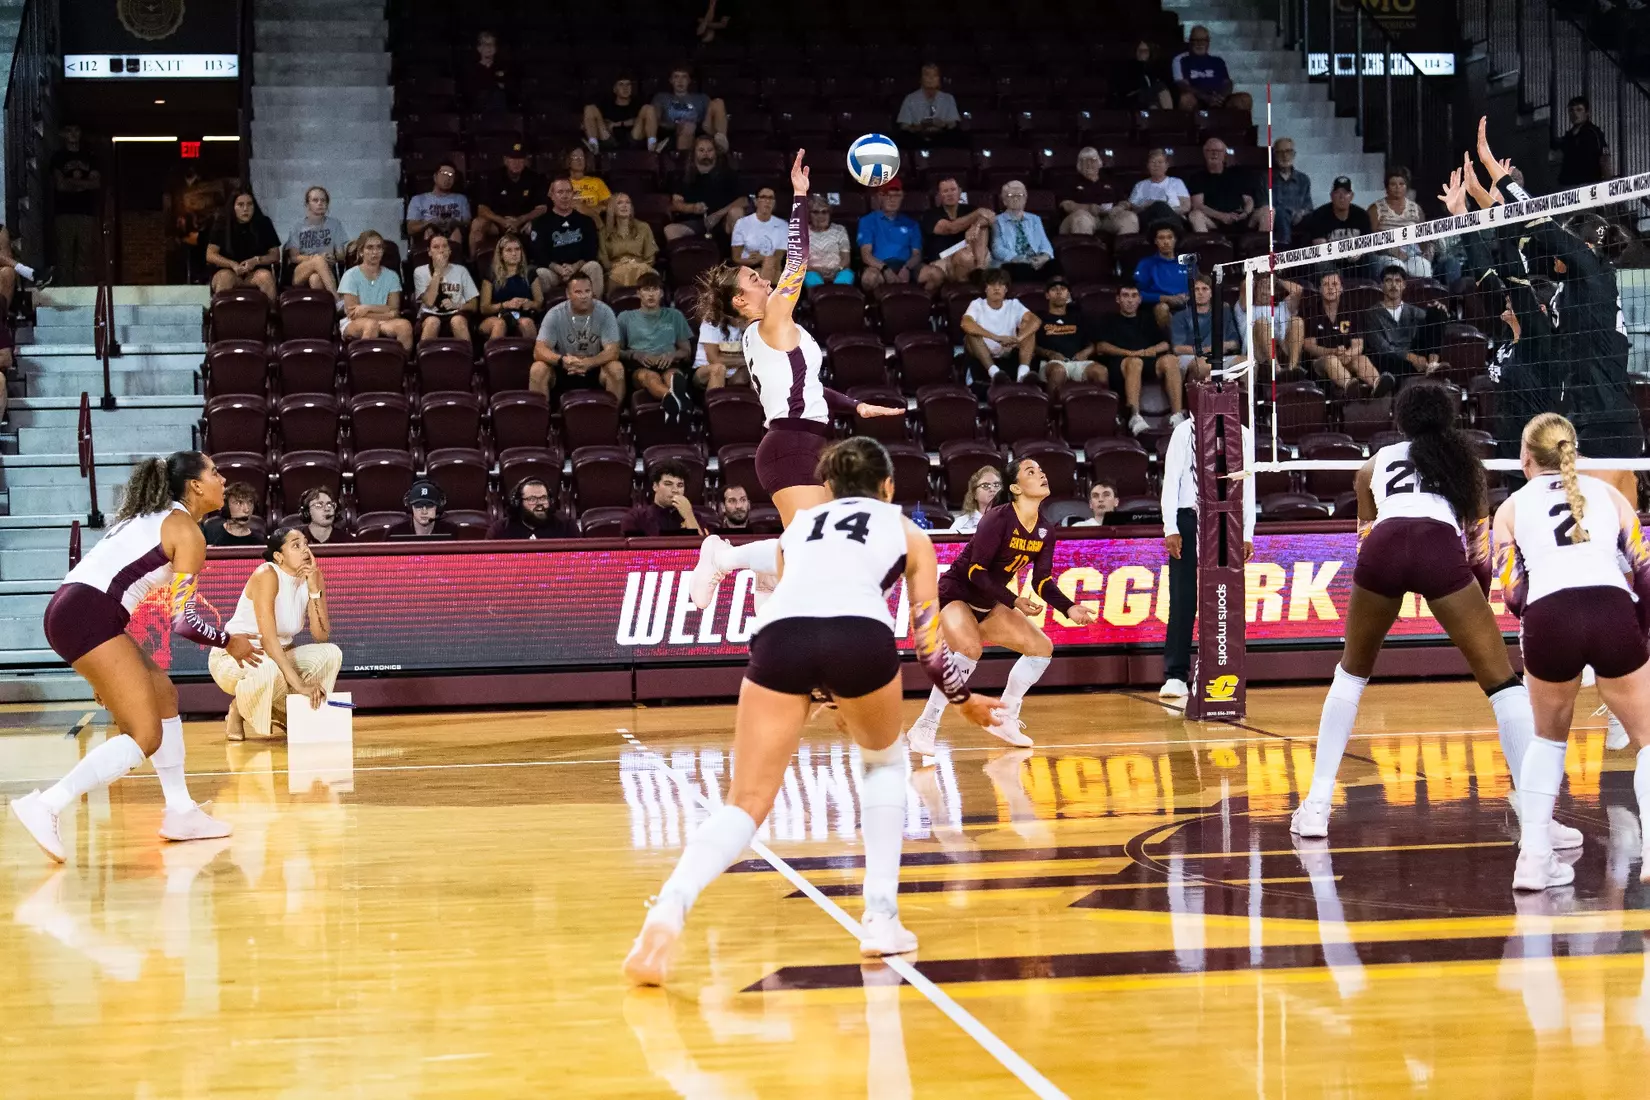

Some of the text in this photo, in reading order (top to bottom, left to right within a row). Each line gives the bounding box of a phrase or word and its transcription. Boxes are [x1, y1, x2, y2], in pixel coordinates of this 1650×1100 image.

[79, 60, 223, 71] 112 EXIT 113
[1424, 59, 1440, 68] 114
[181, 142, 200, 158] EXIT
[1503, 202, 1524, 219] CENTRAL
[1525, 196, 1549, 215] MICHIGAN
[1549, 188, 1580, 209] VOLLEYBALL
[1415, 211, 1481, 239] CENTRAL MICHIGAN VOLLEYBALL
[567, 330, 600, 344] CMU
[805, 511, 872, 545] 14
[1215, 584, 1228, 667] sports imports
